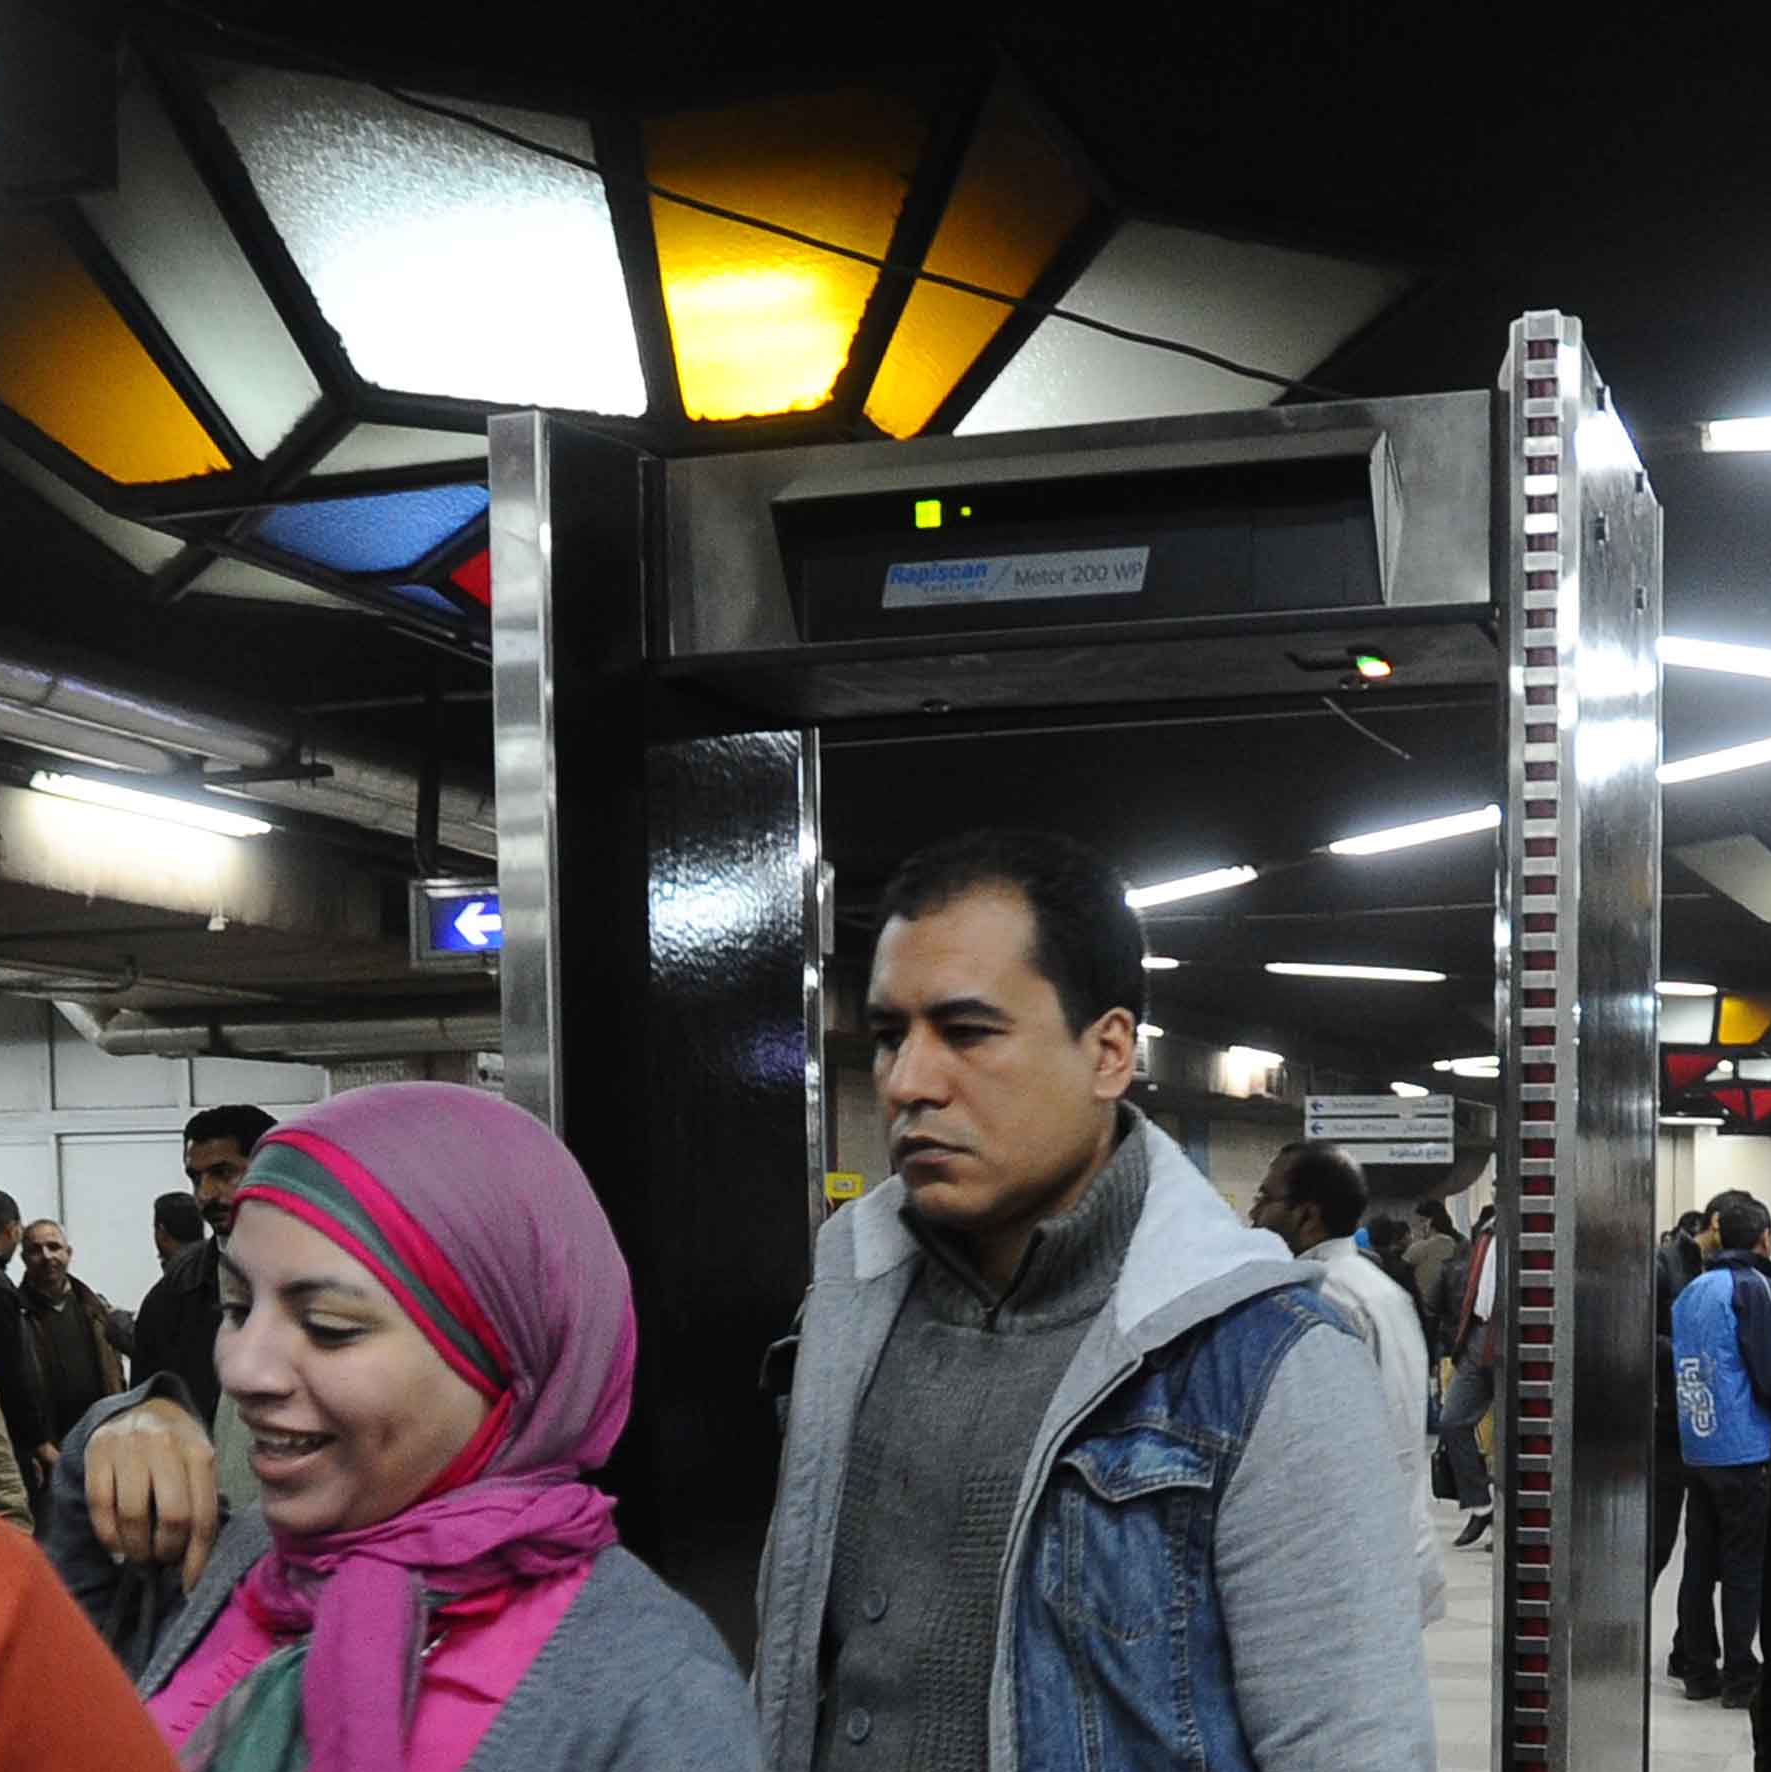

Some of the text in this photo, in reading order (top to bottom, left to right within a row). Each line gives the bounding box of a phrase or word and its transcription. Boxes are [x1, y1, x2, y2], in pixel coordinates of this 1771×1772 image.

[890, 563, 989, 585] Rapiscan
[1071, 564, 1108, 583] 200
[1114, 560, 1144, 581] WP
